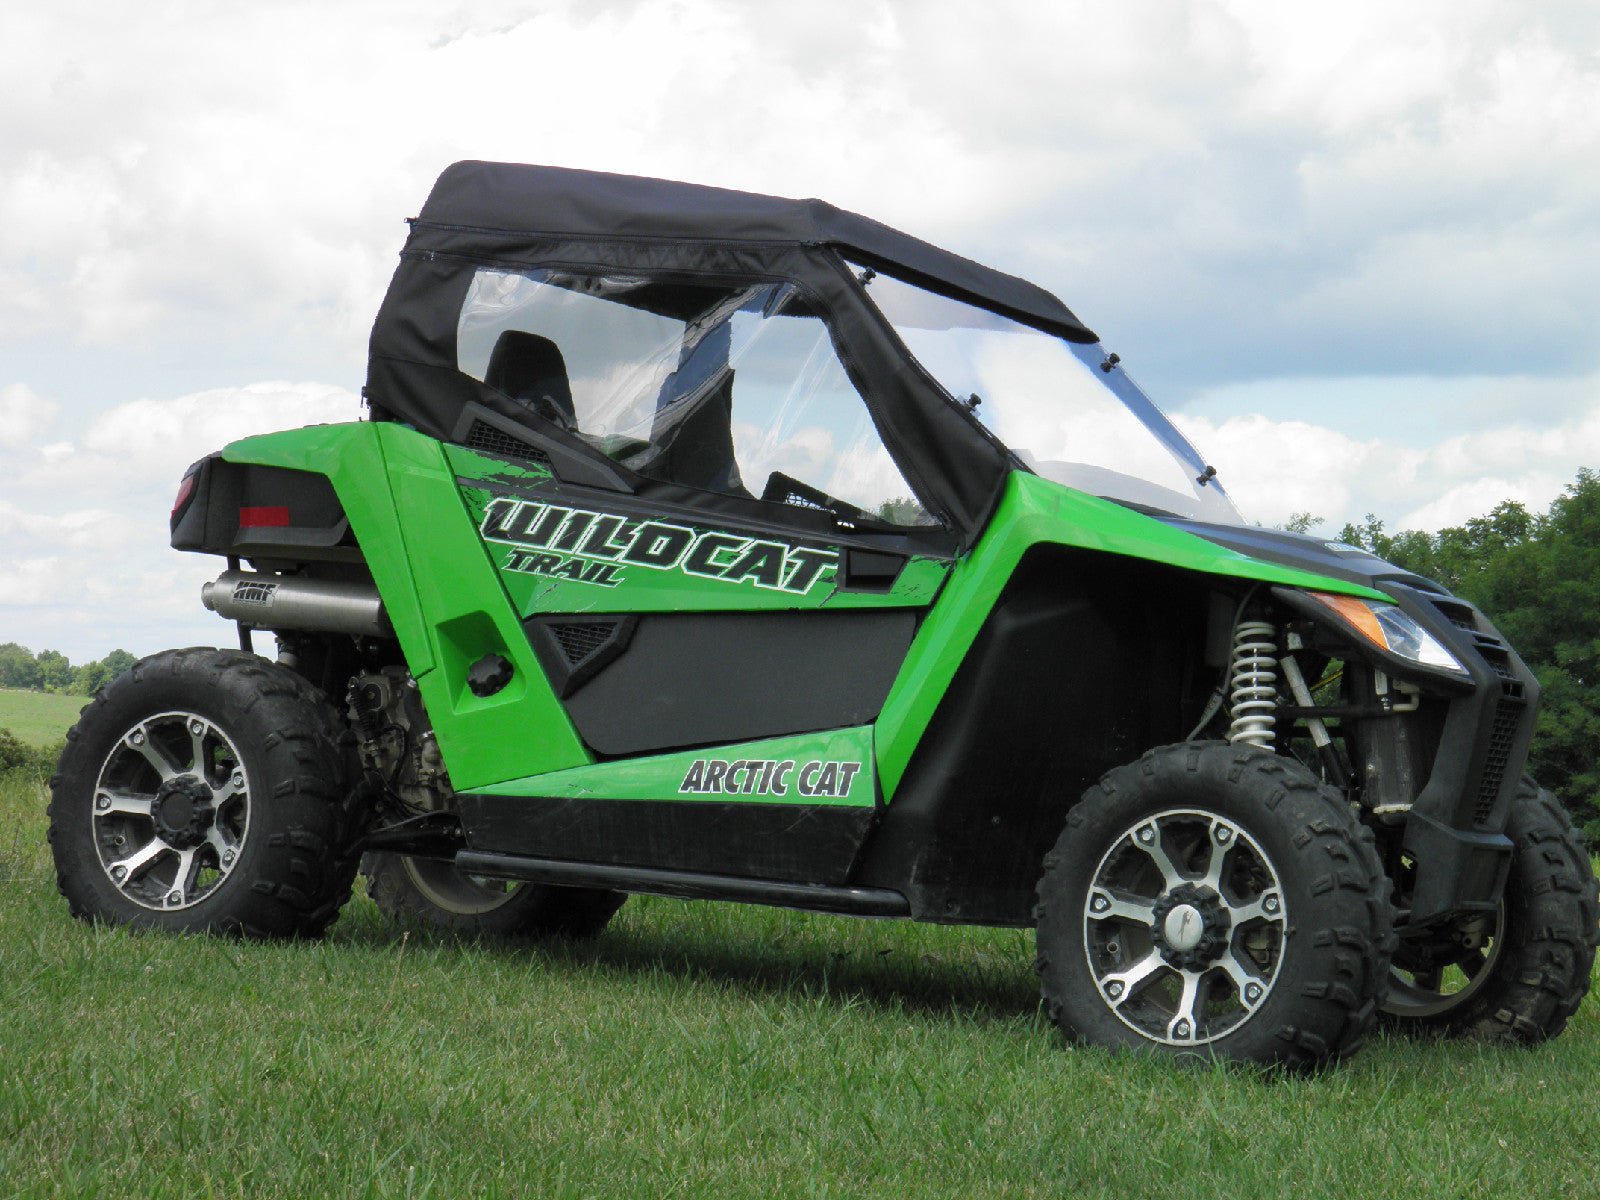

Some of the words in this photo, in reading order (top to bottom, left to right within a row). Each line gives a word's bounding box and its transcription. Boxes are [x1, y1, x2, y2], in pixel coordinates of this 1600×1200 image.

[481, 497, 839, 594] WILDCAT
[502, 548, 628, 588] TRAIL
[678, 759, 795, 796] ARCTIC
[798, 760, 861, 797] CAT
